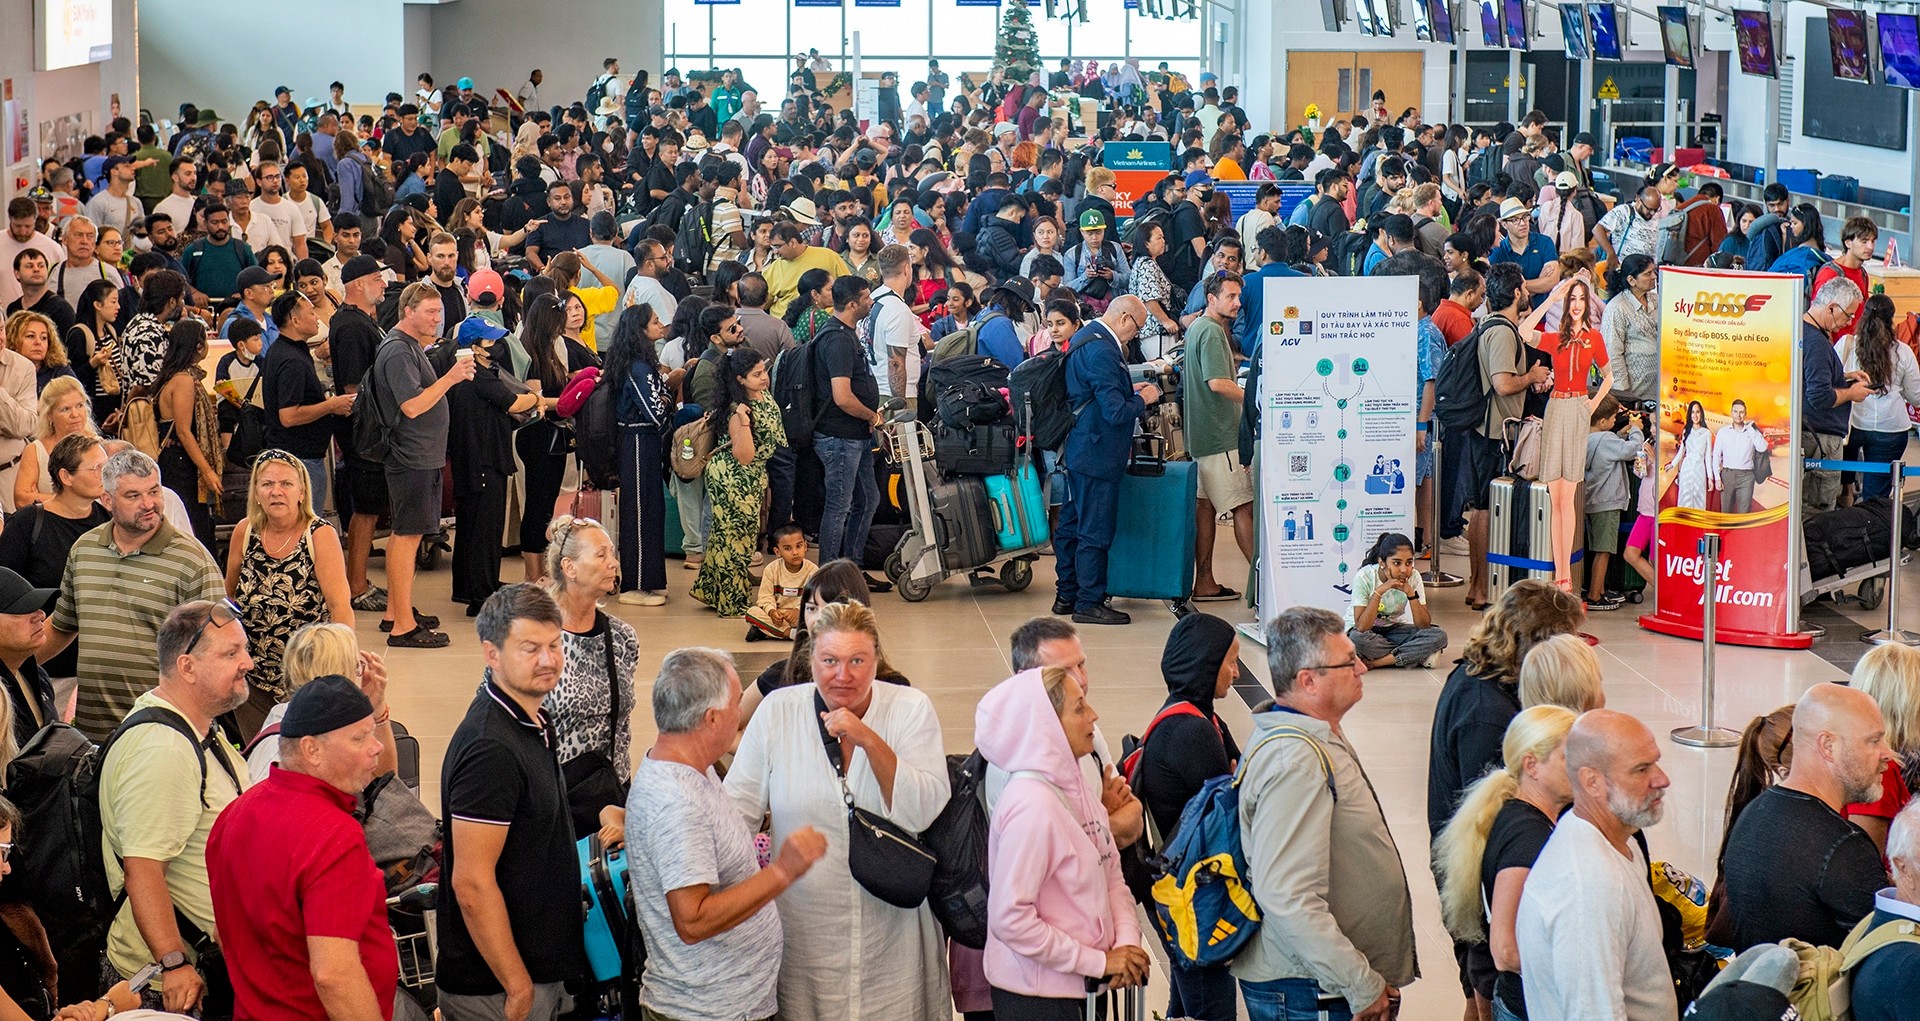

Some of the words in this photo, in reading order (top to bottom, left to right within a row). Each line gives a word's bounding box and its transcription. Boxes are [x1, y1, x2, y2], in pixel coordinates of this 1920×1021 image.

[1115, 192, 1131, 200] KY
[1338, 310, 1359, 319] TRÌNH
[1361, 310, 1376, 318] LÀM
[1378, 309, 1393, 318] THỦ
[1394, 311, 1409, 319] TỤC
[1331, 321, 1345, 329] TÀU
[1363, 320, 1373, 328] VÀ
[1375, 320, 1389, 328] XÁC
[1392, 321, 1411, 329] THỰC
[1340, 330, 1358, 339] TRẮC
[1360, 332, 1375, 340] HỌC
[1698, 584, 1774, 607] ir.com
